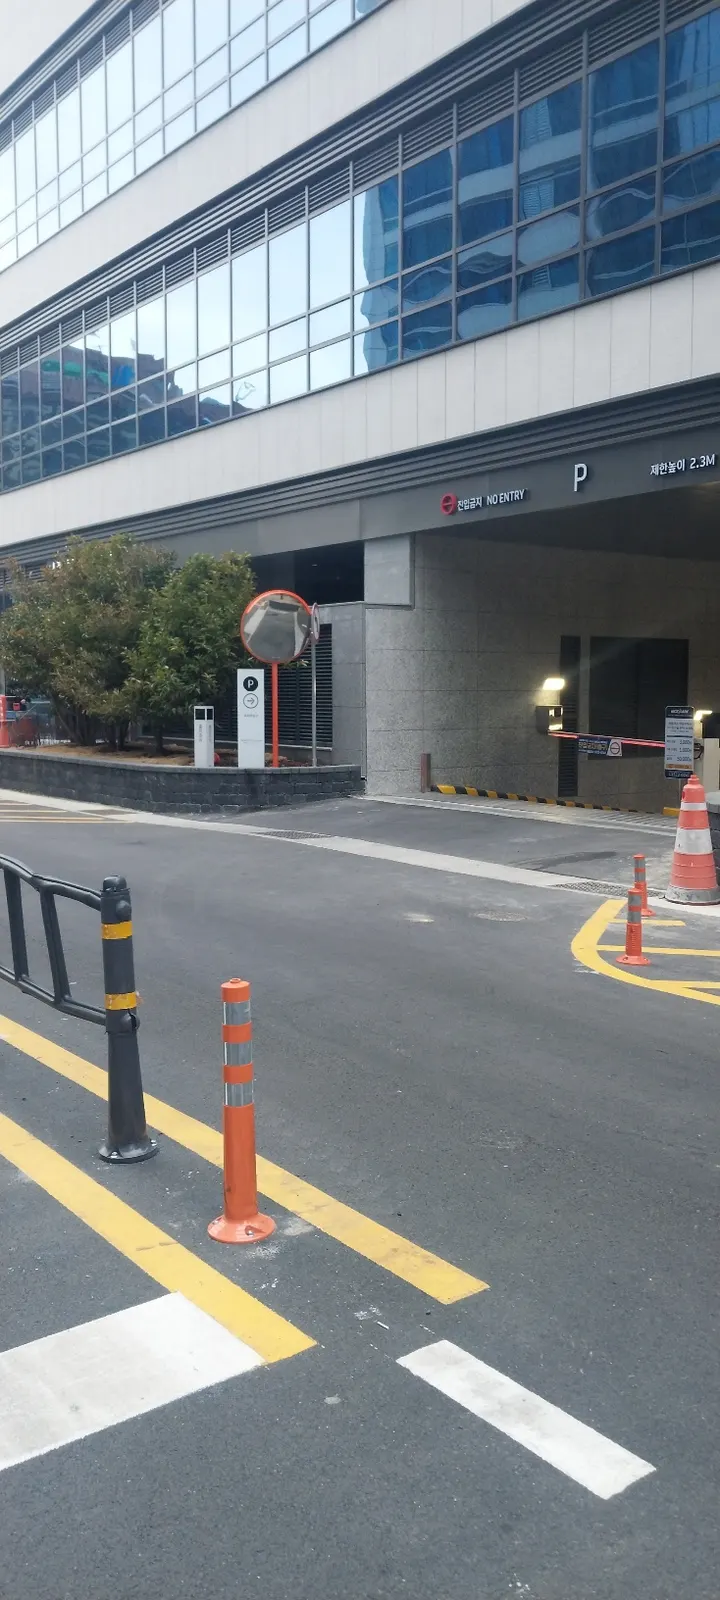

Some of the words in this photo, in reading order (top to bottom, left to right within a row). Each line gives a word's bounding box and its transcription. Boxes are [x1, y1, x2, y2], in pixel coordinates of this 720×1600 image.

[650, 459, 685, 476] 제한높이
[689, 453, 715, 469] 2.3M
[574, 464, 588, 492] P
[457, 496, 483, 511] 진입금지
[486, 494, 498, 506] NO
[499, 488, 525, 504] ENTRY
[247, 679, 254, 688] P
